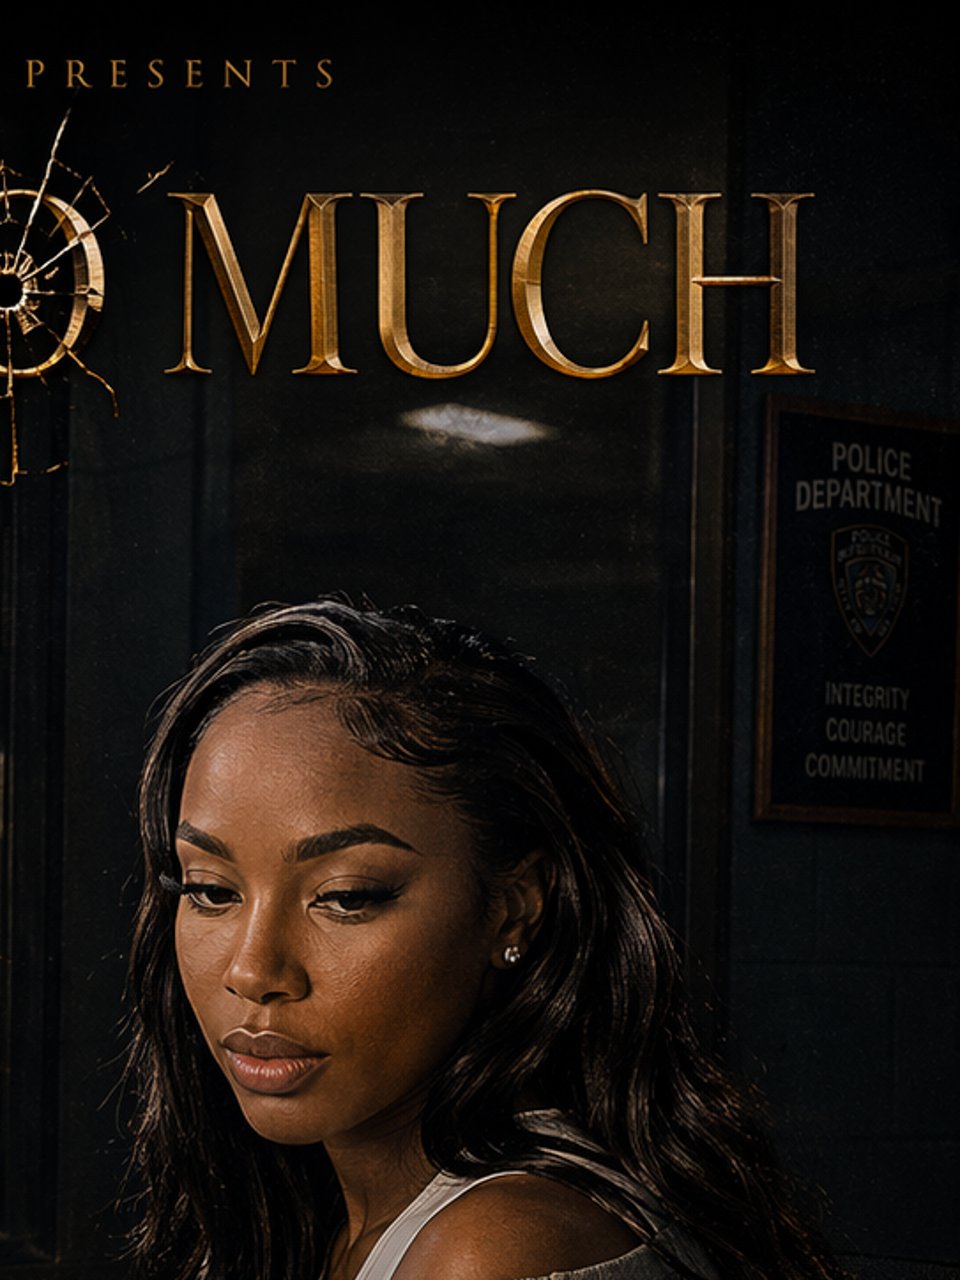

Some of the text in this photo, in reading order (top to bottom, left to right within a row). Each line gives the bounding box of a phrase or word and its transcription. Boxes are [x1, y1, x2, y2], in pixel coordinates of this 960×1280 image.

[831, 441, 913, 482] POLICE
[794, 479, 944, 529] DEPARTMENT
[824, 680, 911, 713] INTEGRITY
[824, 716, 908, 748] COURAGE
[804, 752, 927, 784] COMMITMENT
